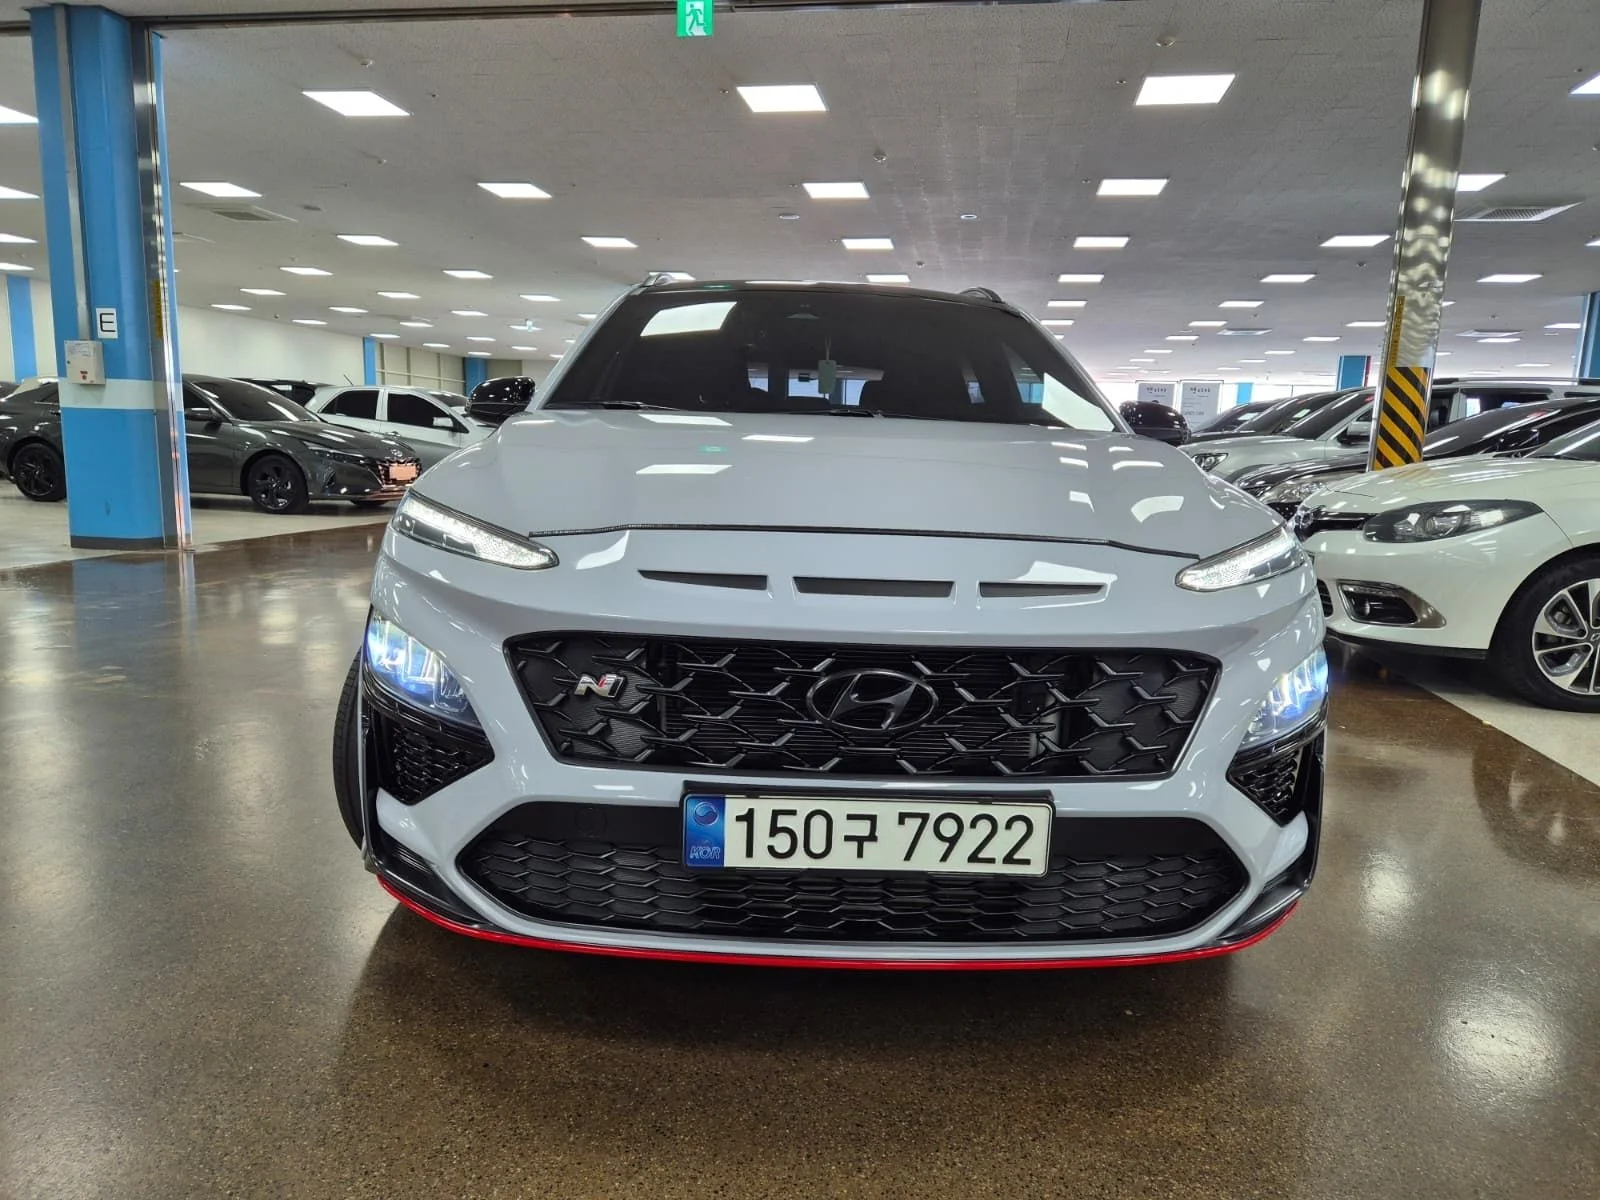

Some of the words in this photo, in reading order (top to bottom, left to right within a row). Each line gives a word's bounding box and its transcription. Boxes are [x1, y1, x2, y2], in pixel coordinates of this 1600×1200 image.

[99, 312, 116, 333] E
[735, 807, 878, 860] 150구
[898, 811, 1034, 866] 7922
[689, 846, 721, 860] KOR
